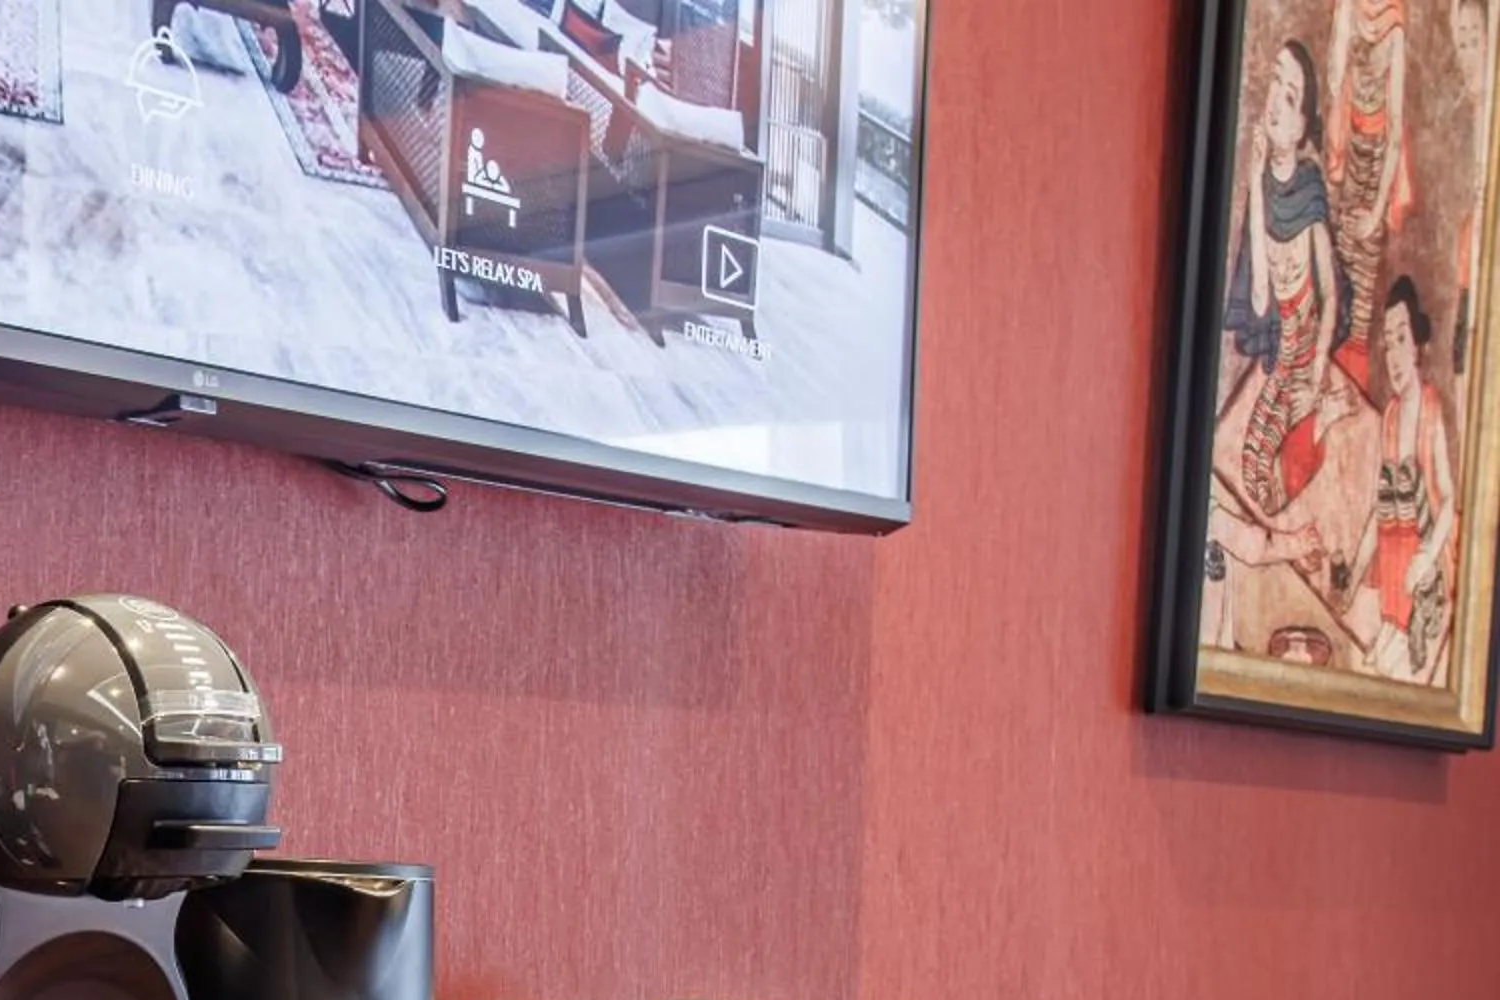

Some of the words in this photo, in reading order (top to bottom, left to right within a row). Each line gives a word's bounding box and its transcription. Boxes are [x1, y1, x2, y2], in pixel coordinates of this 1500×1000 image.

[130, 162, 196, 201] DINING
[433, 245, 469, 274] LET'S
[471, 254, 516, 288] RELAX
[516, 267, 544, 293] SPA
